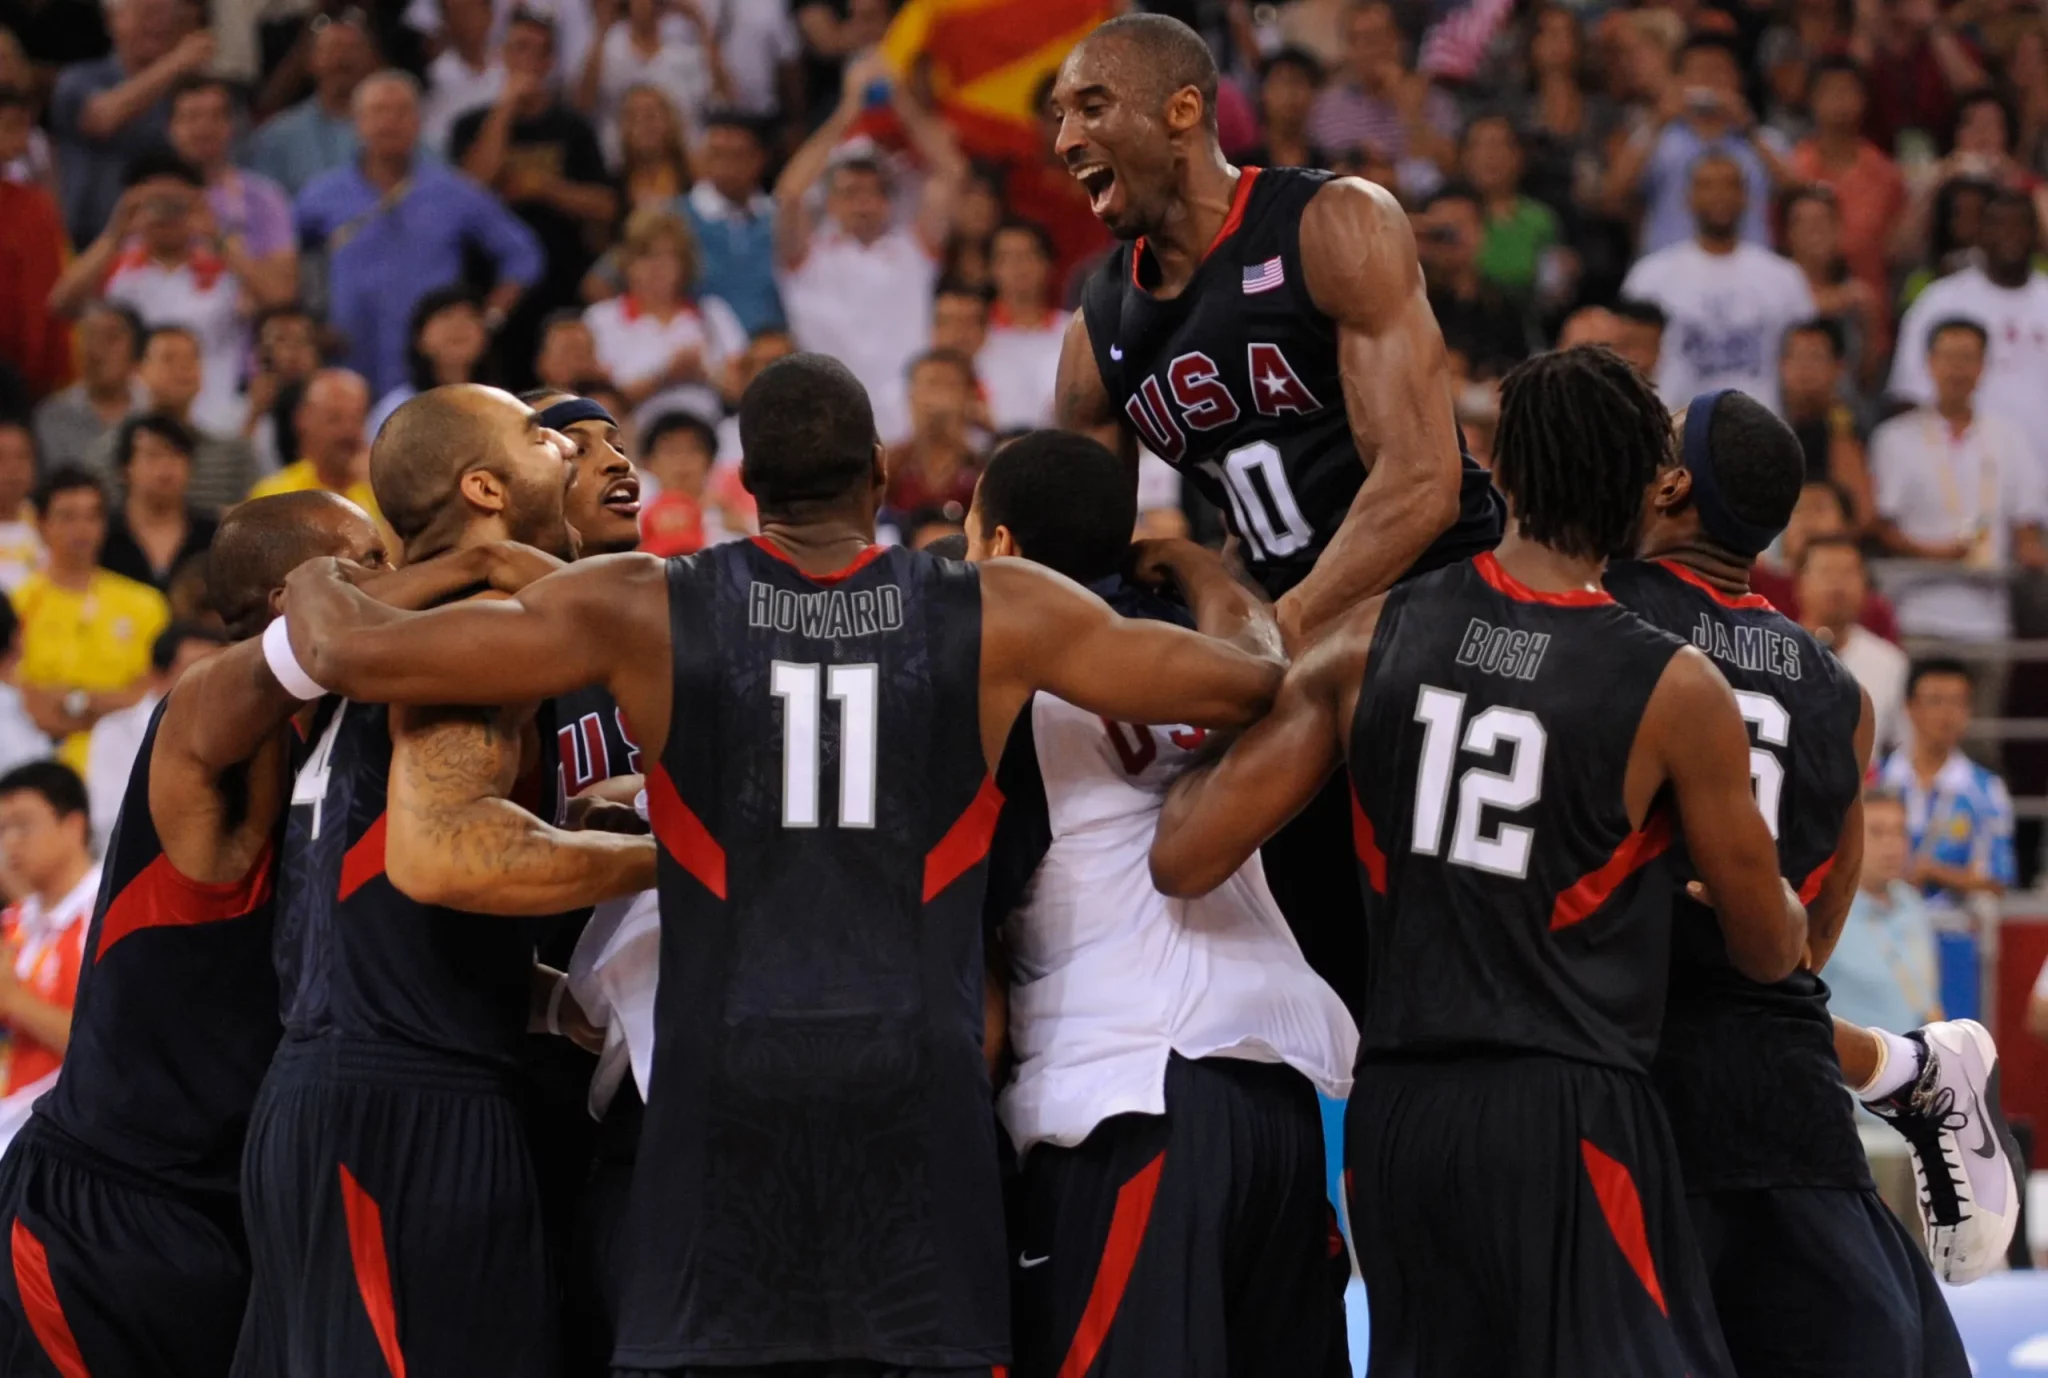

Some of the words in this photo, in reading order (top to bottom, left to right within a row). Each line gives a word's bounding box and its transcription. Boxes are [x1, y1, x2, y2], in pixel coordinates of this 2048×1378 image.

[1125, 342, 1324, 462] USA
[1195, 439, 1315, 562] 10
[749, 580, 904, 639] HOWARD
[1455, 617, 1552, 681] BOSH
[1692, 611, 1801, 681] JAMES
[770, 659, 879, 829] 11
[1411, 683, 1548, 880] 12
[1733, 687, 1791, 841] 6
